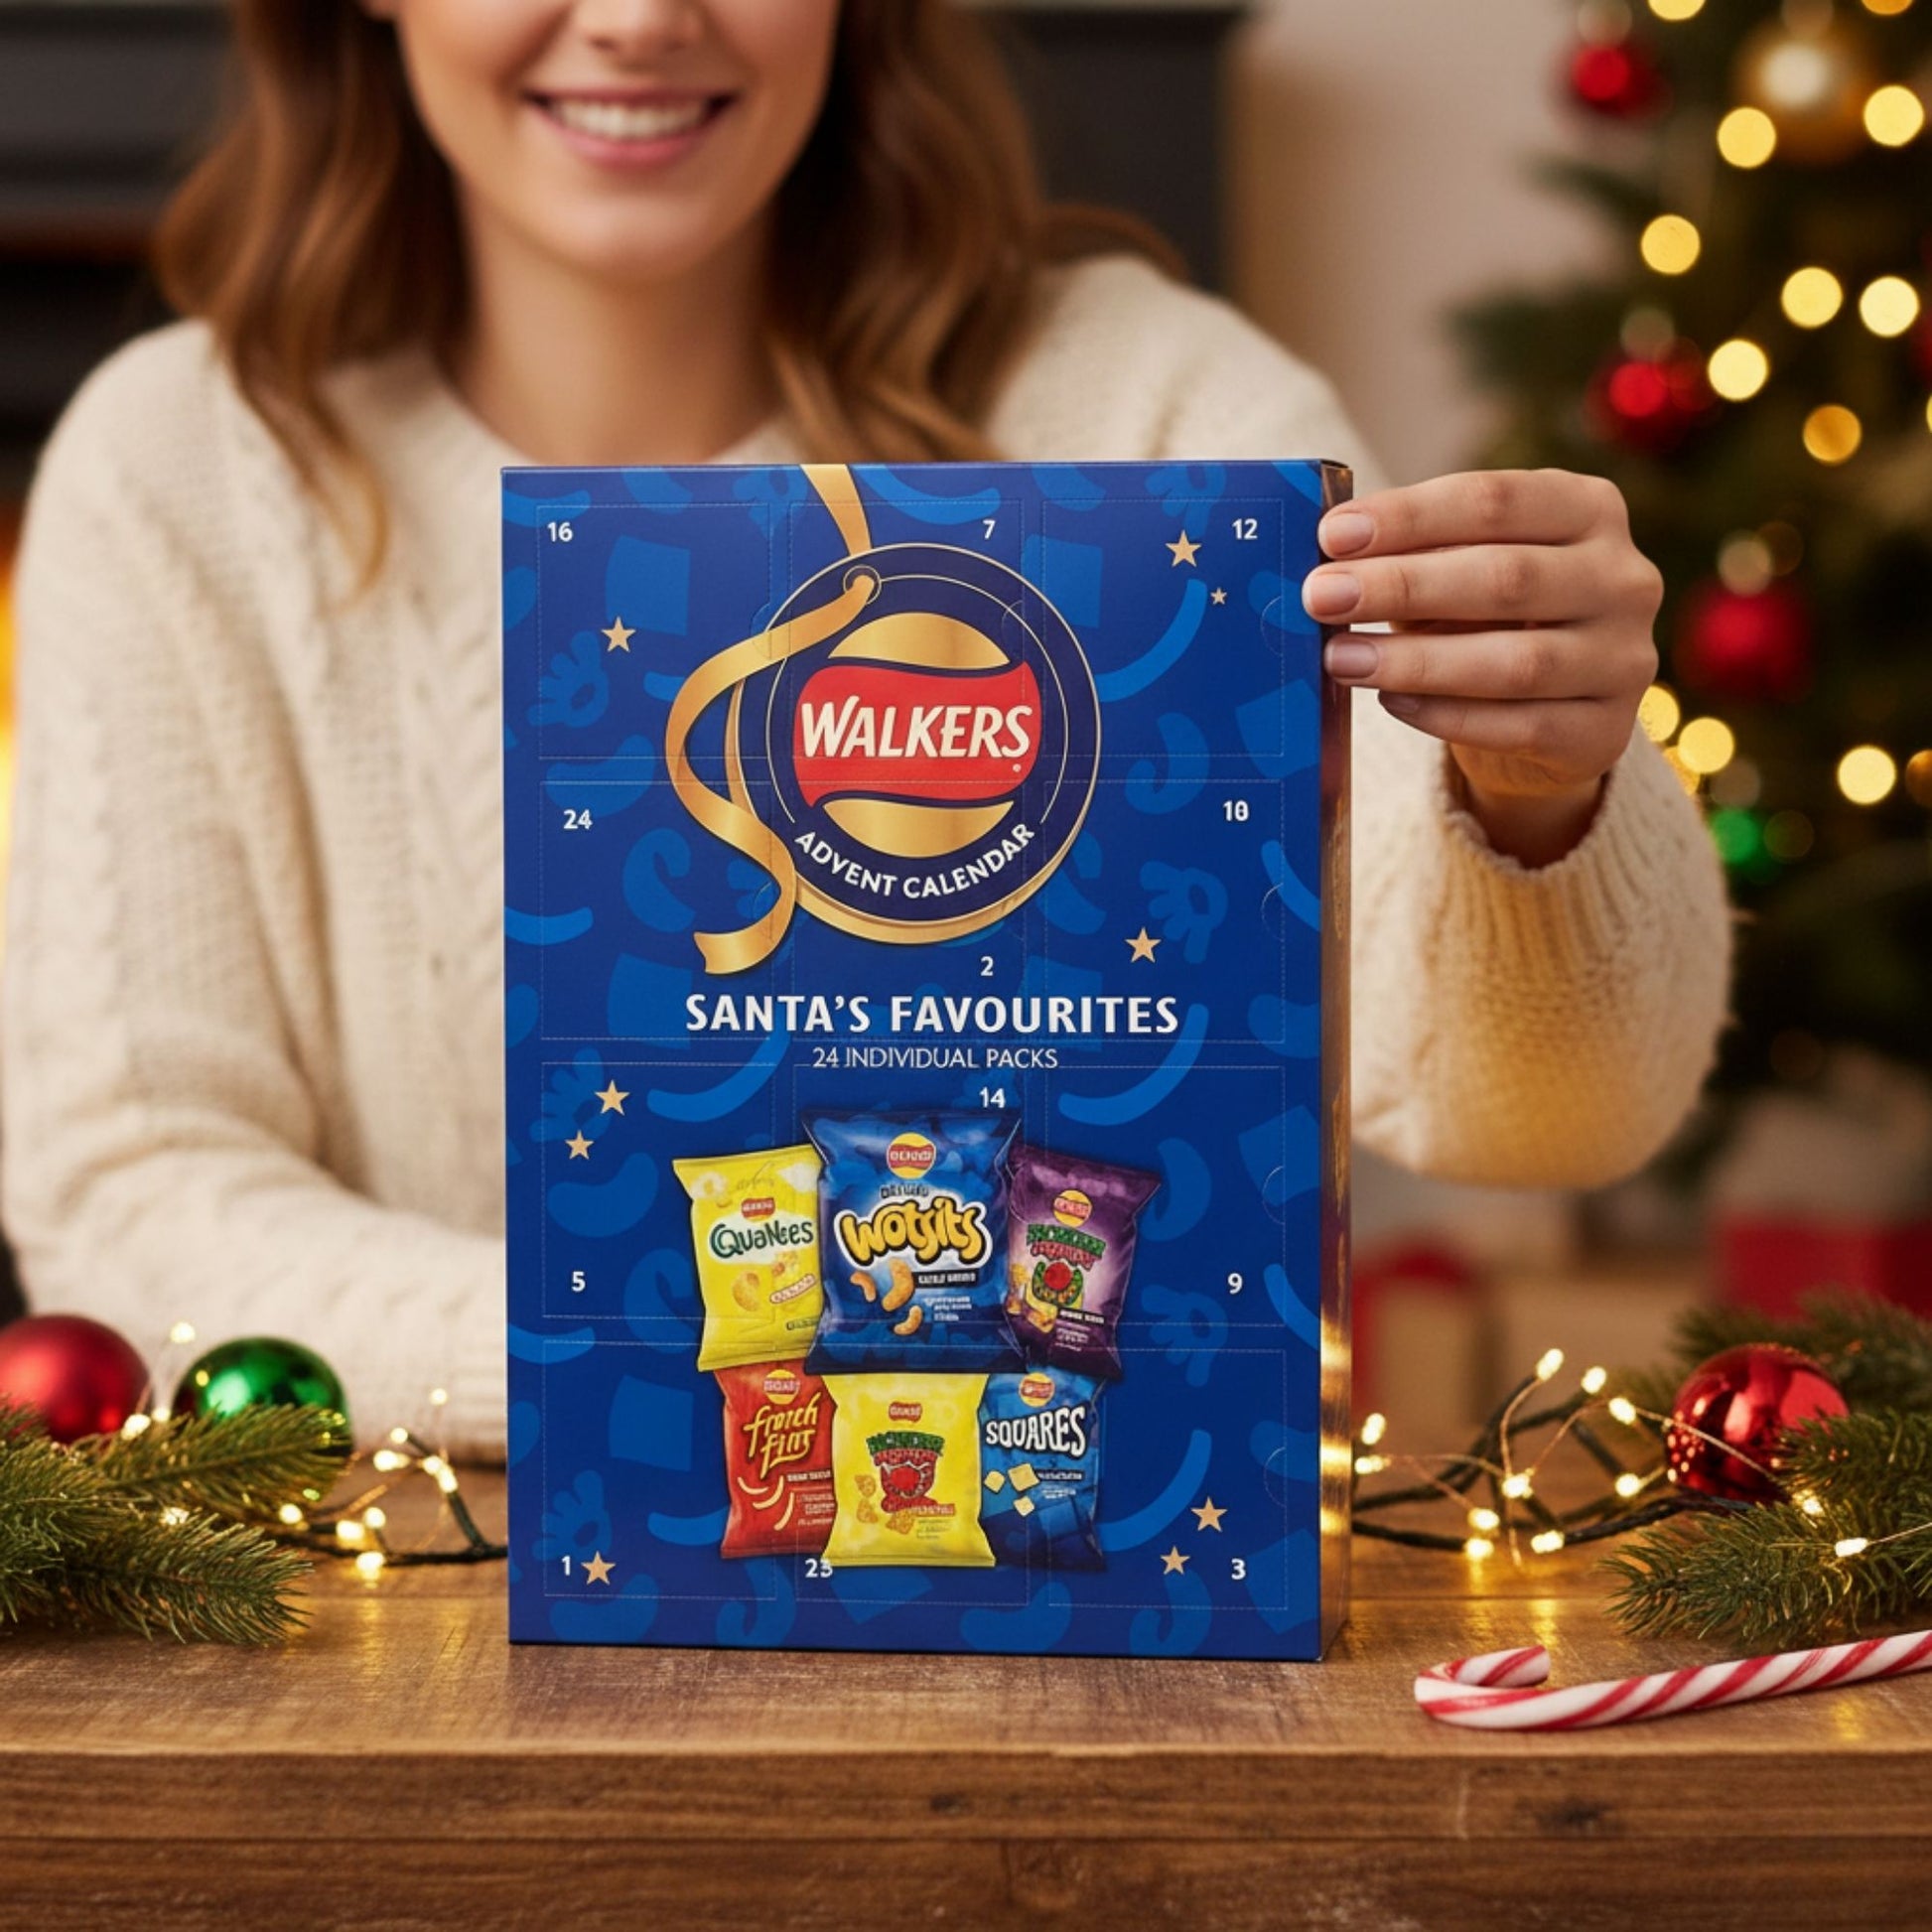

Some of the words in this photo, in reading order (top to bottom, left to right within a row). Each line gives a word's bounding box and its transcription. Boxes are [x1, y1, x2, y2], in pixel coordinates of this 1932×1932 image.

[547, 521, 574, 543] 16
[982, 519, 996, 540] 7
[1232, 518, 1259, 540] 12
[800, 694, 1034, 759] WALKERS
[562, 809, 594, 830] 24
[794, 831, 897, 897] ADVENT
[901, 822, 1035, 898] CALENDAR
[980, 955, 995, 977] 2
[685, 993, 872, 1033] SANTA'S
[891, 996, 1179, 1035] FAVOURITES
[812, 1046, 840, 1068] 24
[845, 1046, 981, 1069] INDIVIDUAL
[986, 1047, 1058, 1069] PACKS
[979, 1086, 1007, 1109] 14
[571, 1270, 587, 1293] 5
[1227, 1273, 1243, 1295] 9
[561, 1555, 571, 1577] 1
[1230, 1558, 1247, 1581] 3
